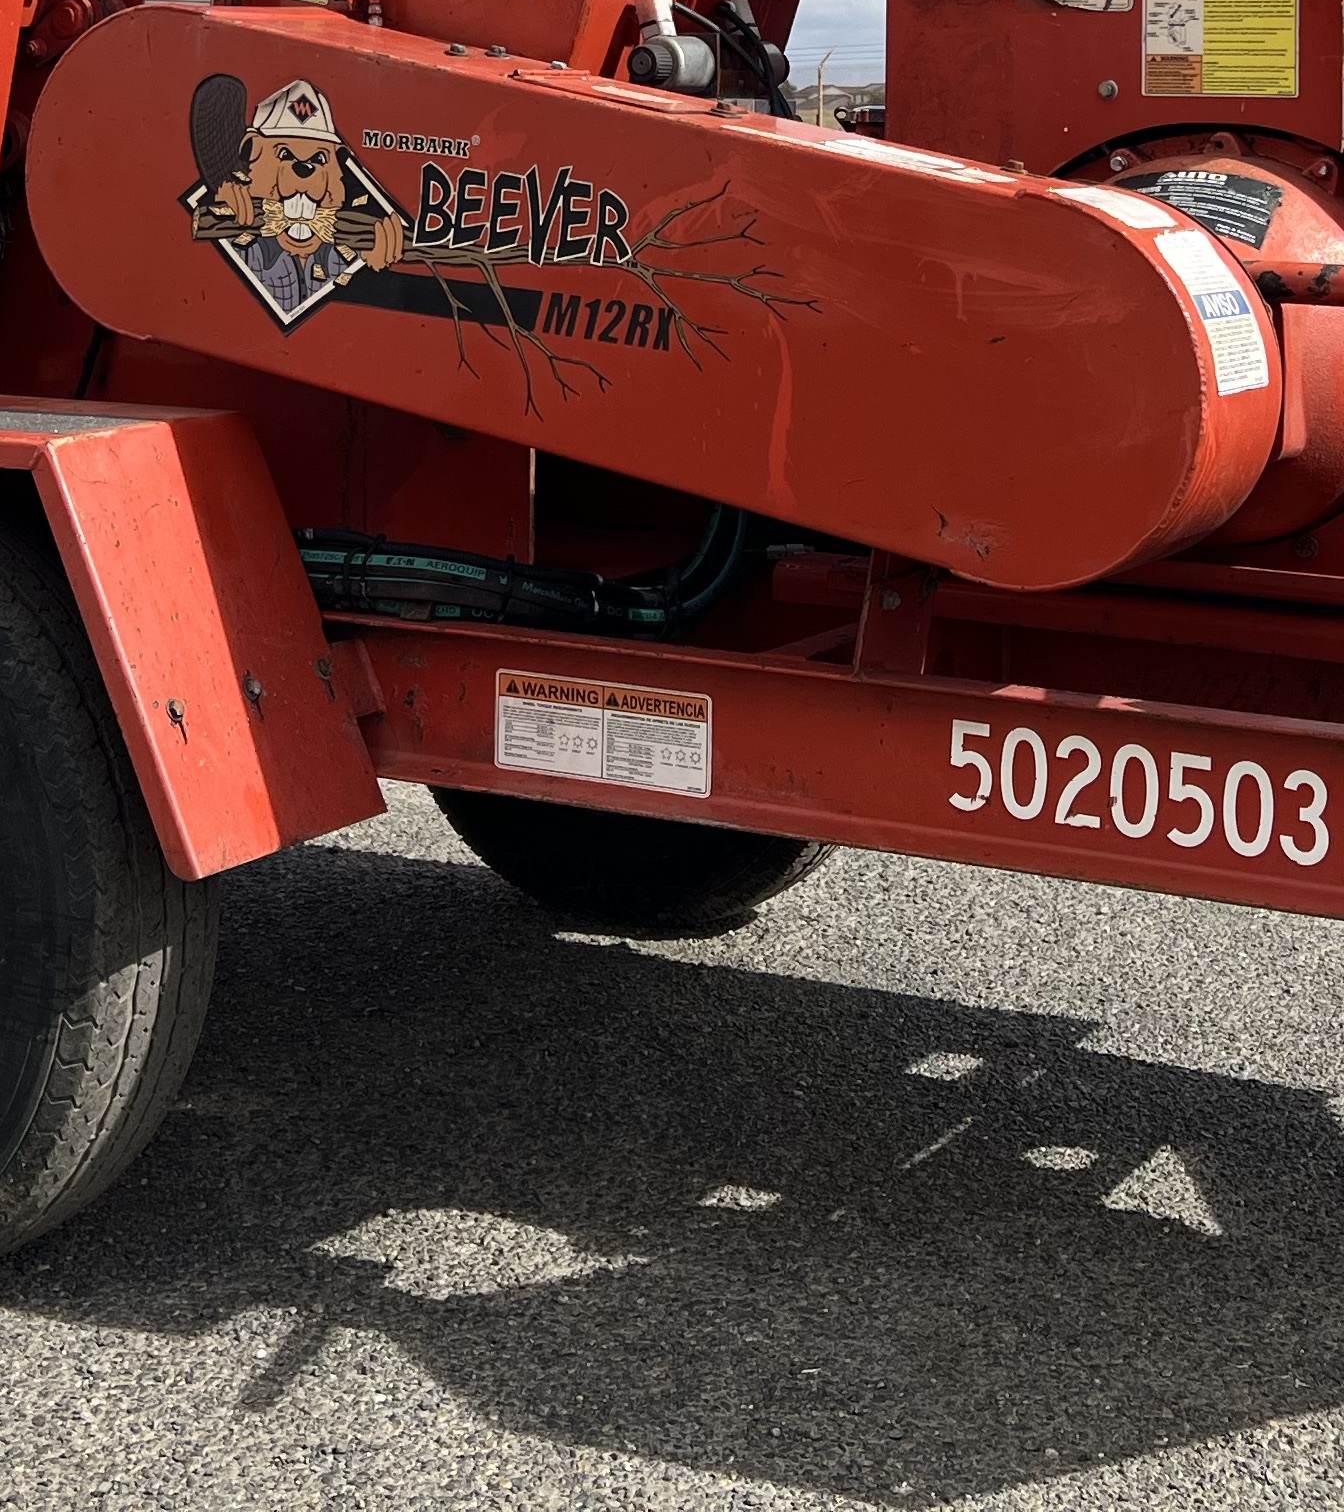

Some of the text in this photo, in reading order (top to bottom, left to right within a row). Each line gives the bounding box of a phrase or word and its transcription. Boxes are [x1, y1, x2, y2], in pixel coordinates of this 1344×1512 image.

[412, 160, 632, 267] BEEVER
[1201, 291, 1239, 318] AVISO
[542, 292, 675, 351] M12RX
[425, 560, 485, 577] AEROQUIP
[522, 681, 599, 704] WARNING
[621, 694, 705, 719] ADVERTENCIA
[948, 718, 1330, 866] 5020503
